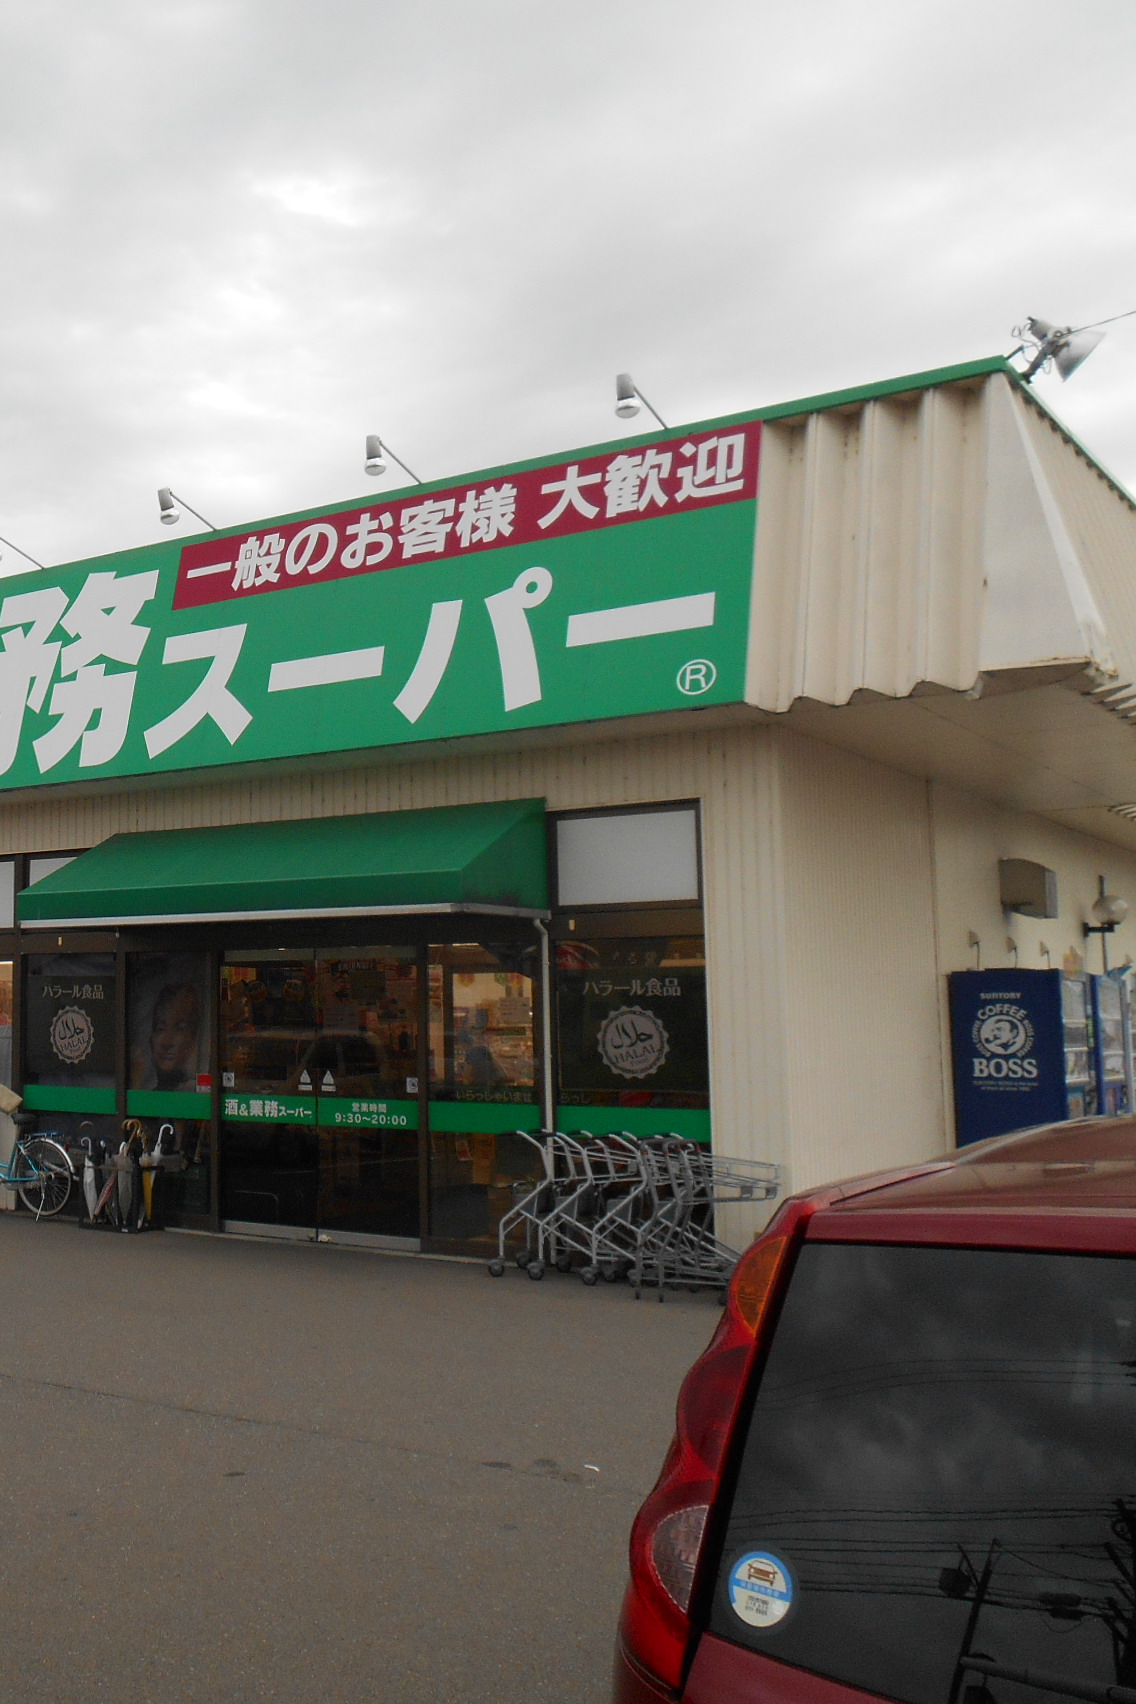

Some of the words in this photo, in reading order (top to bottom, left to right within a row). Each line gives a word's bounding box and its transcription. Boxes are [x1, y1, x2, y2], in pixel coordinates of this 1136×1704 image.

[186, 484, 519, 591] 一般のお客様
[537, 433, 746, 529] 大歓迎
[42, 984, 104, 999] ハラール食品
[582, 977, 682, 997] ハラール食品
[977, 1003, 1027, 1020] COFFEE
[972, 1058, 1038, 1078] BOSS
